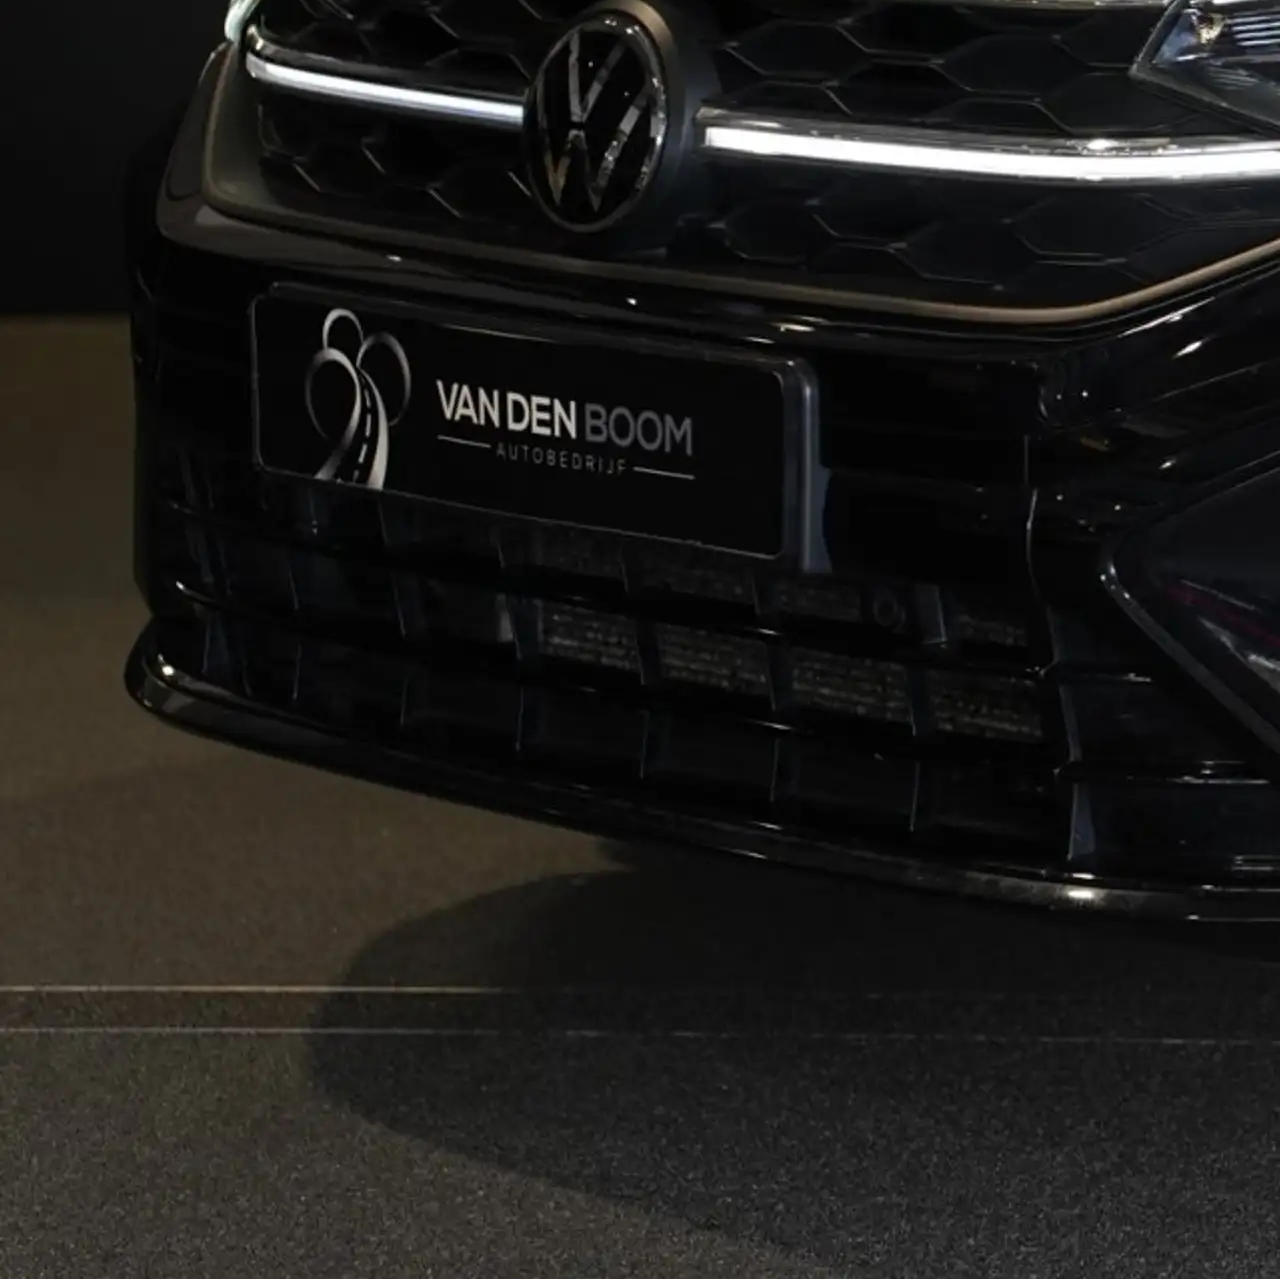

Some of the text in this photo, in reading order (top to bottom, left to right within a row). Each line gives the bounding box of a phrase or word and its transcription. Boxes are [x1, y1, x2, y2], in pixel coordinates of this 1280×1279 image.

[435, 378, 693, 457] VAN DEN BOOM
[495, 441, 628, 476] AUTOBEDRIJF
